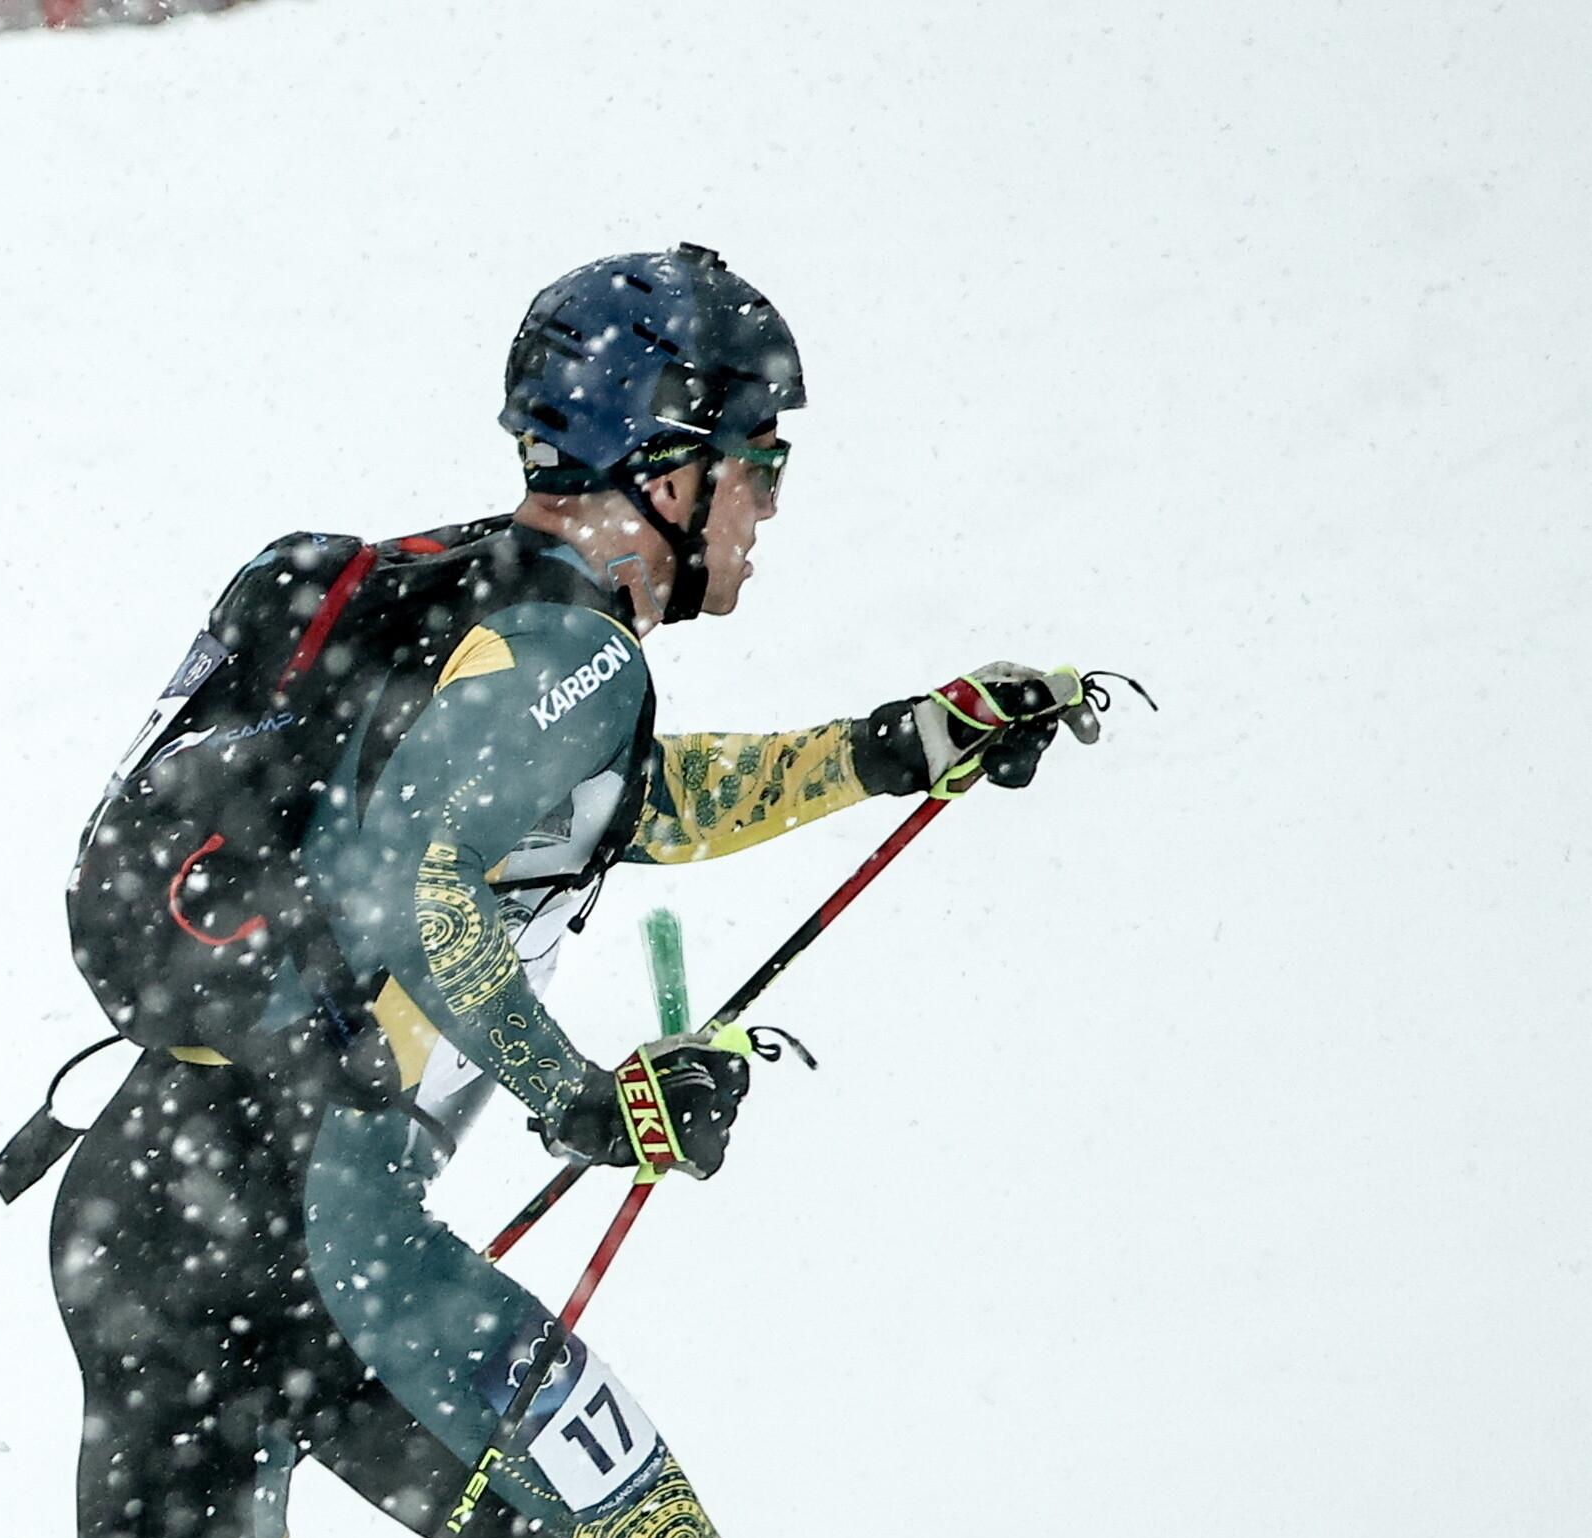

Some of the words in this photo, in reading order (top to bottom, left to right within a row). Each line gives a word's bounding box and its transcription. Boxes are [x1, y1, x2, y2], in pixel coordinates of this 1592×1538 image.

[528, 634, 632, 731] KARBON
[617, 1061, 672, 1154] LEKI
[560, 1382, 634, 1476] 17
[446, 1446, 505, 1534] LEKI
